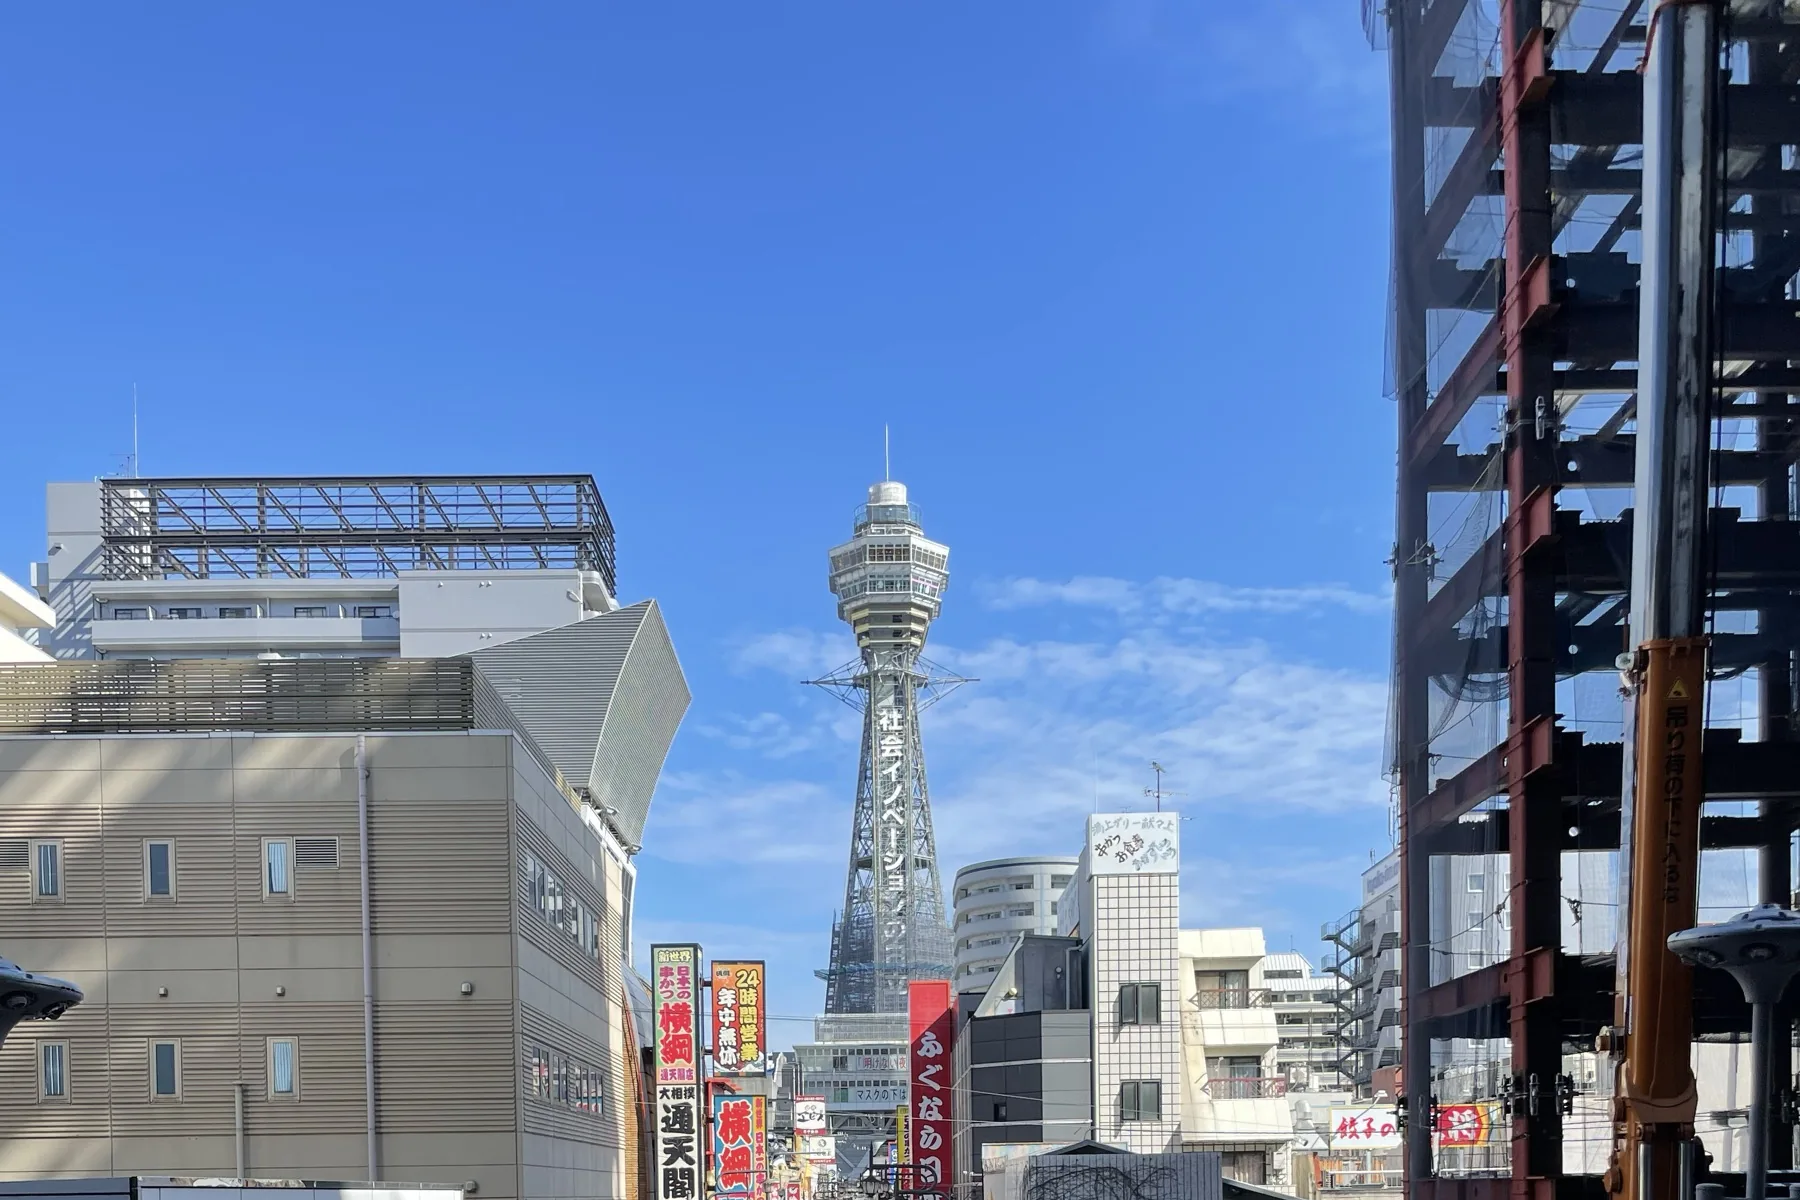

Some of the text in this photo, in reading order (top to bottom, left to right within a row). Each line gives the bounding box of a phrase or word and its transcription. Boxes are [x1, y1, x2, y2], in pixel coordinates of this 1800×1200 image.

[658, 950, 692, 963] 新世界
[659, 966, 675, 999] 串かつ
[676, 966, 692, 999] 日本一の
[718, 988, 737, 1066] 年中無休
[735, 970, 761, 1061] 24時間営業
[659, 1002, 693, 1065] 横綱
[659, 1086, 695, 1100] 大相撲
[857, 1090, 906, 1101] マスクの下は
[1336, 1116, 1396, 1140] 餃子の
[660, 1102, 696, 1200] 通天閣
[717, 1100, 752, 1190] 横綱
